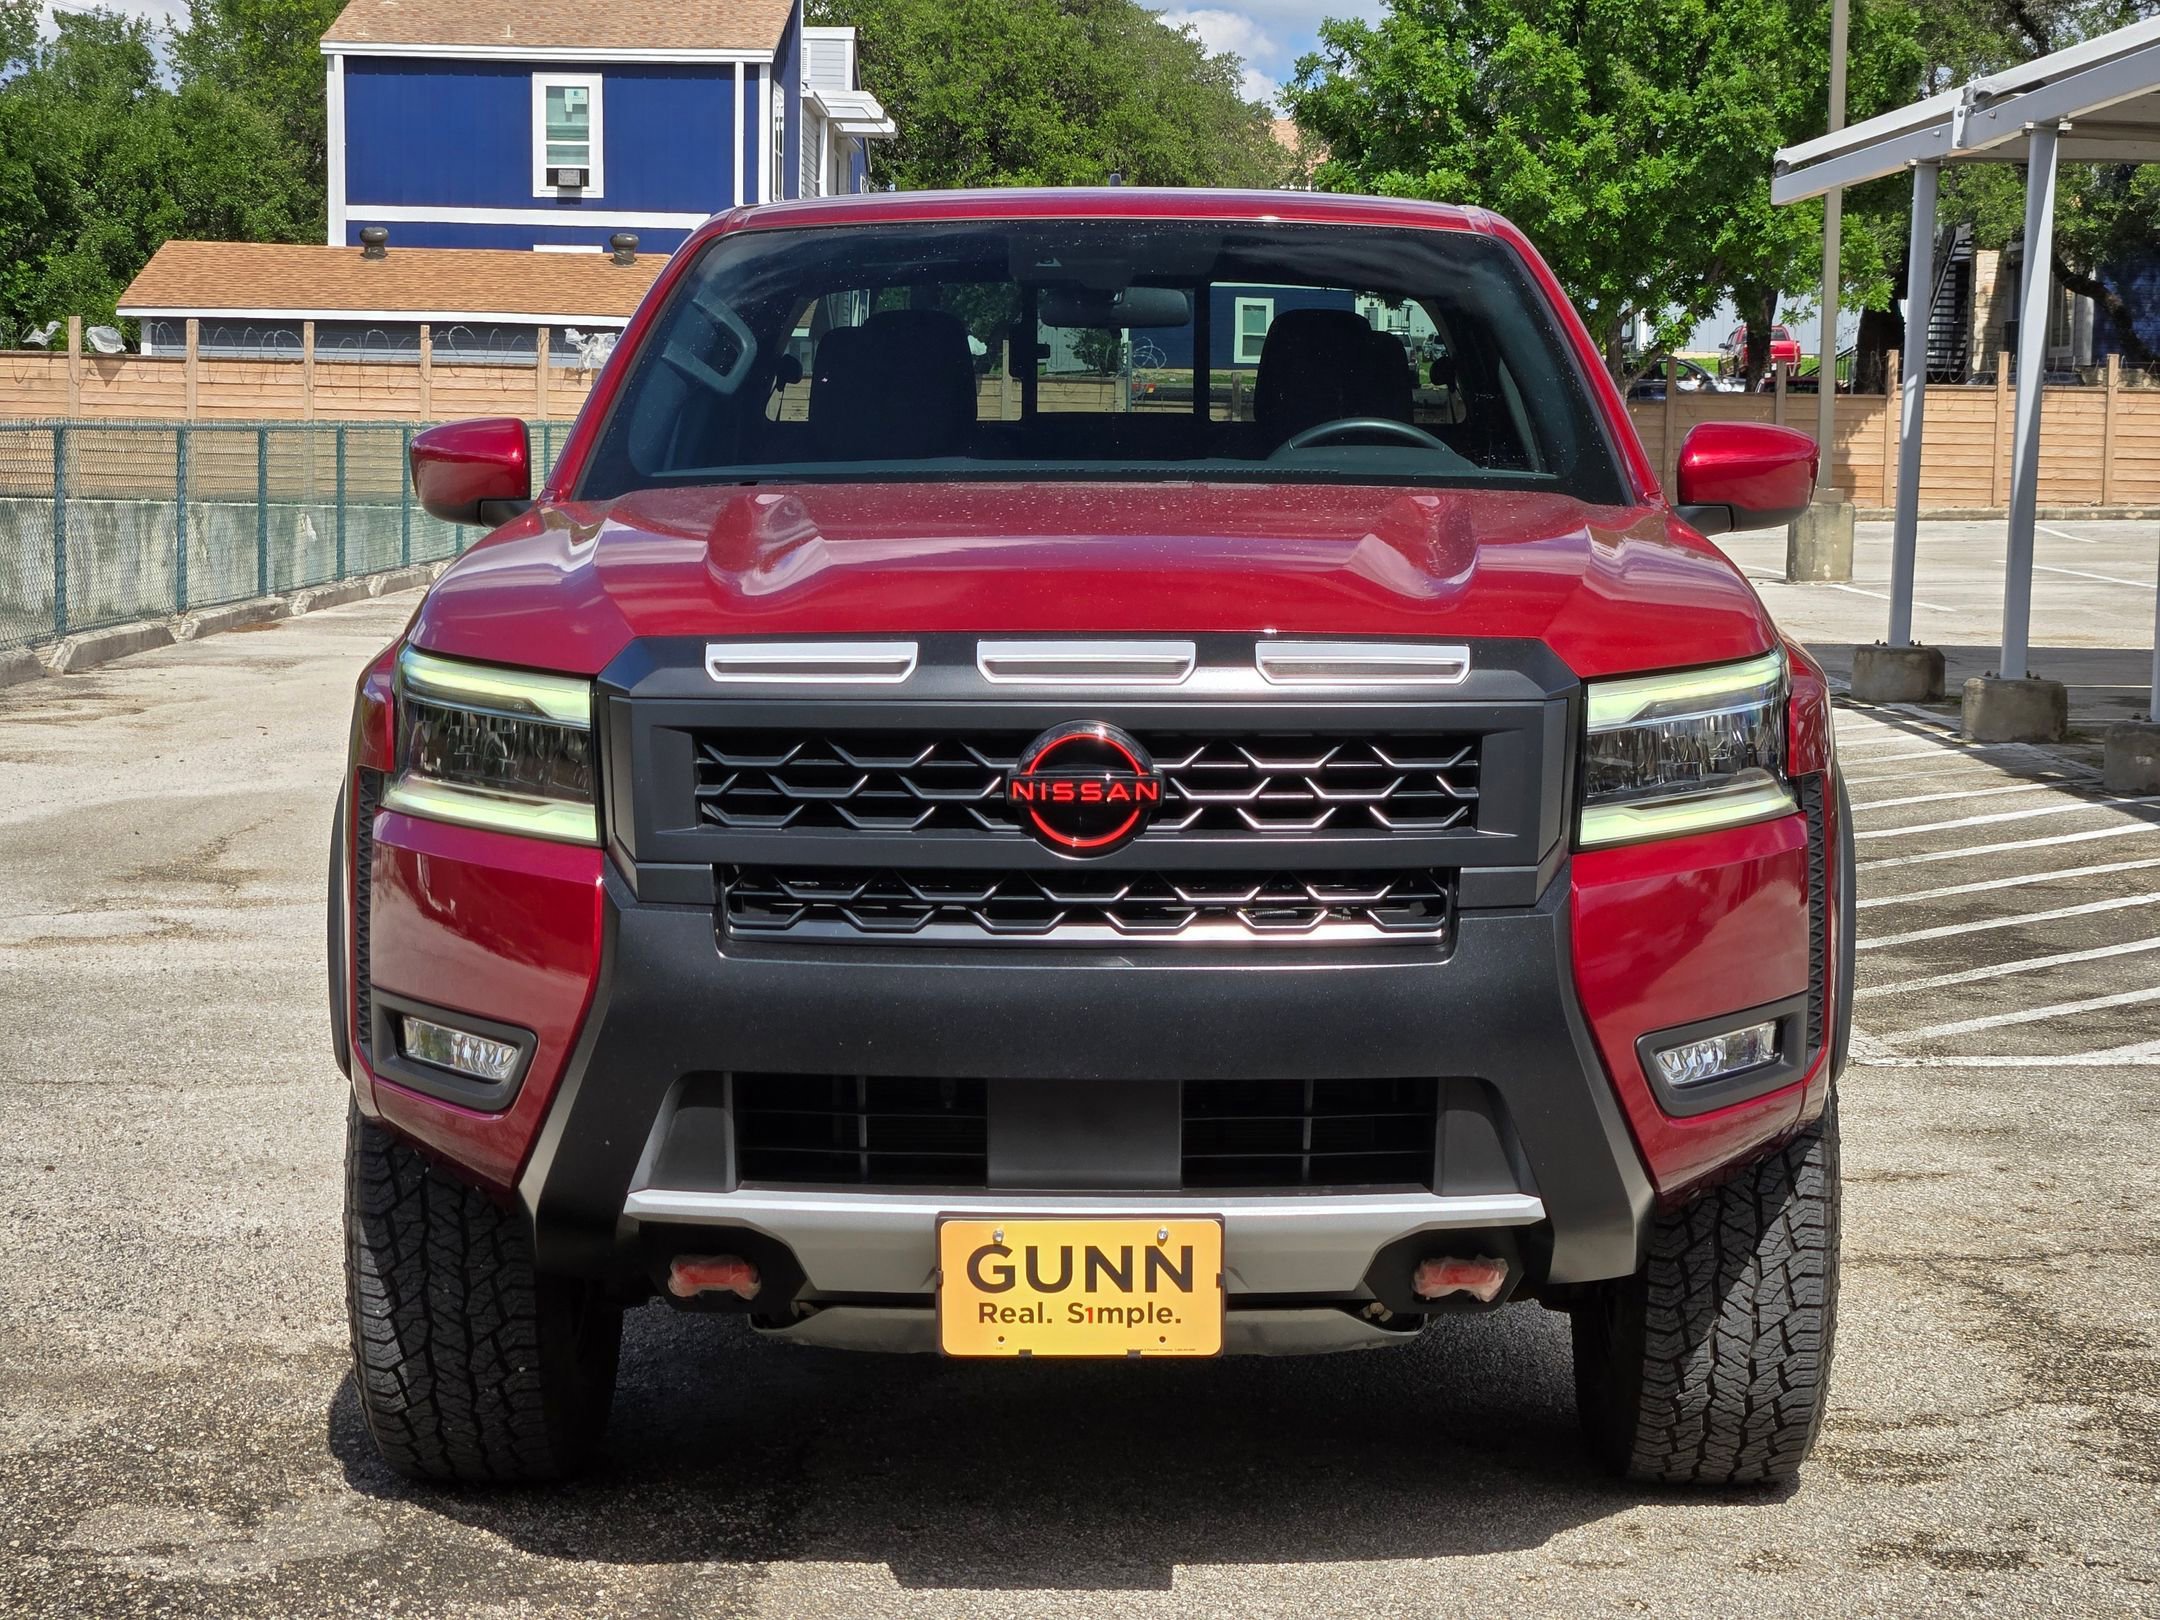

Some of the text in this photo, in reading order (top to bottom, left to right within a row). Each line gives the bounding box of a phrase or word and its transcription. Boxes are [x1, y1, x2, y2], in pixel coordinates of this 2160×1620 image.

[1012, 782, 1159, 801] NISSAN
[966, 1244, 1193, 1293] GUNN
[978, 1302, 1053, 1324] Real.
